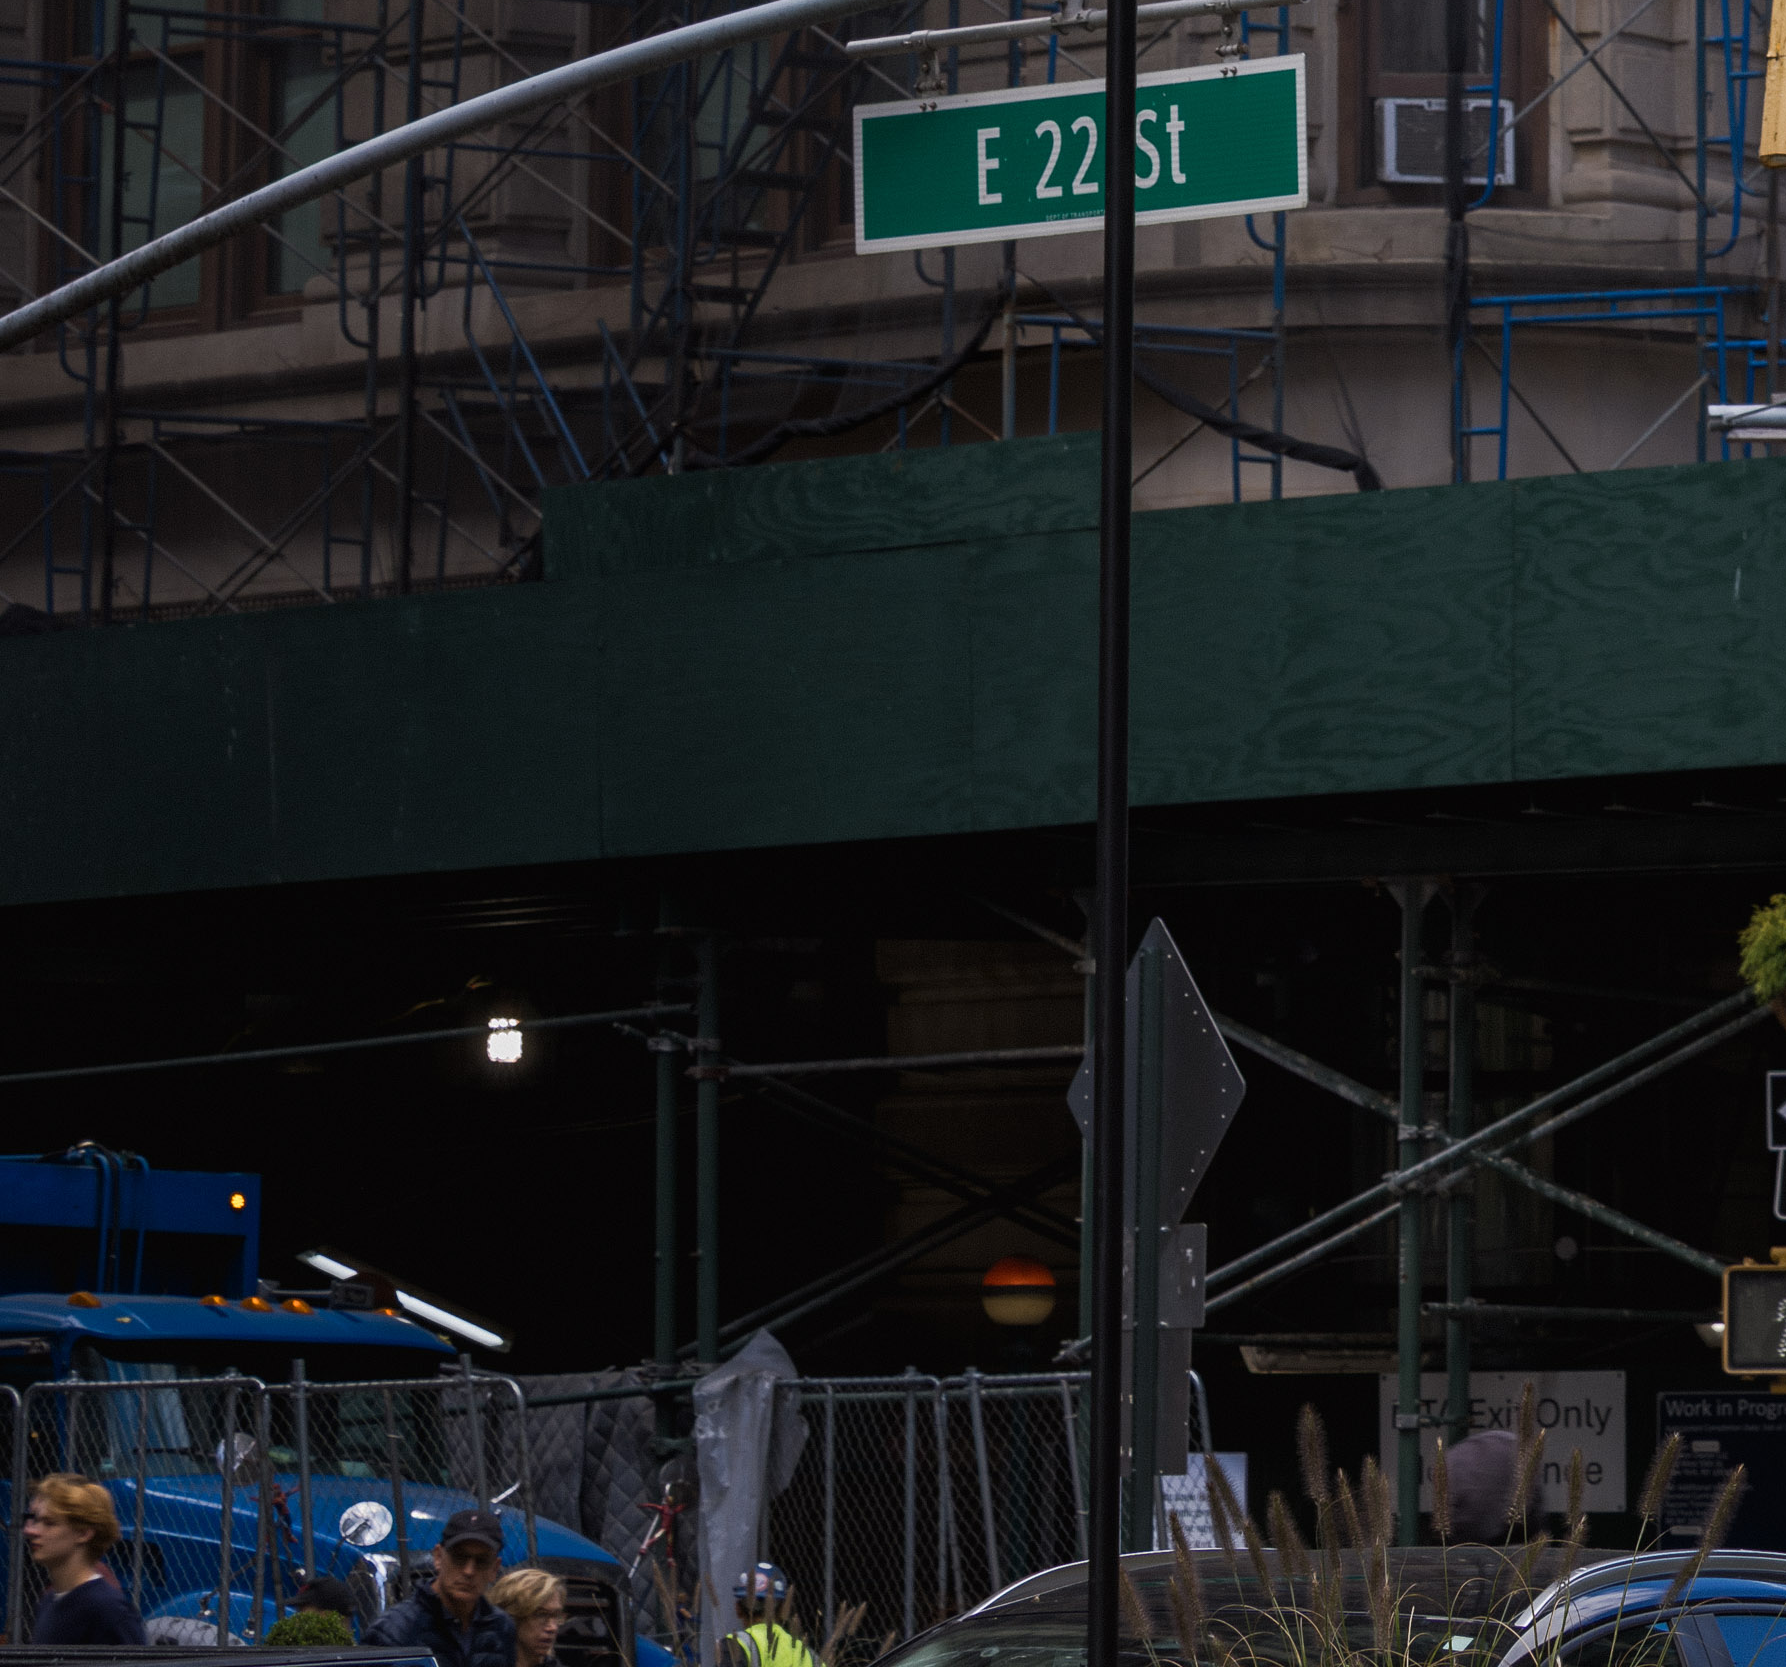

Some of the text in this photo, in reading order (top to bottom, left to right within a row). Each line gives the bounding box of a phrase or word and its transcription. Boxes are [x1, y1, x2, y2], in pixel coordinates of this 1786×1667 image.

[977, 104, 1186, 205] E 22 St
[1070, 209, 1104, 218] TRANSPORT
[1537, 1398, 1612, 1435] Only
[1665, 1398, 1712, 1417] Work
[1716, 1399, 1733, 1417] in
